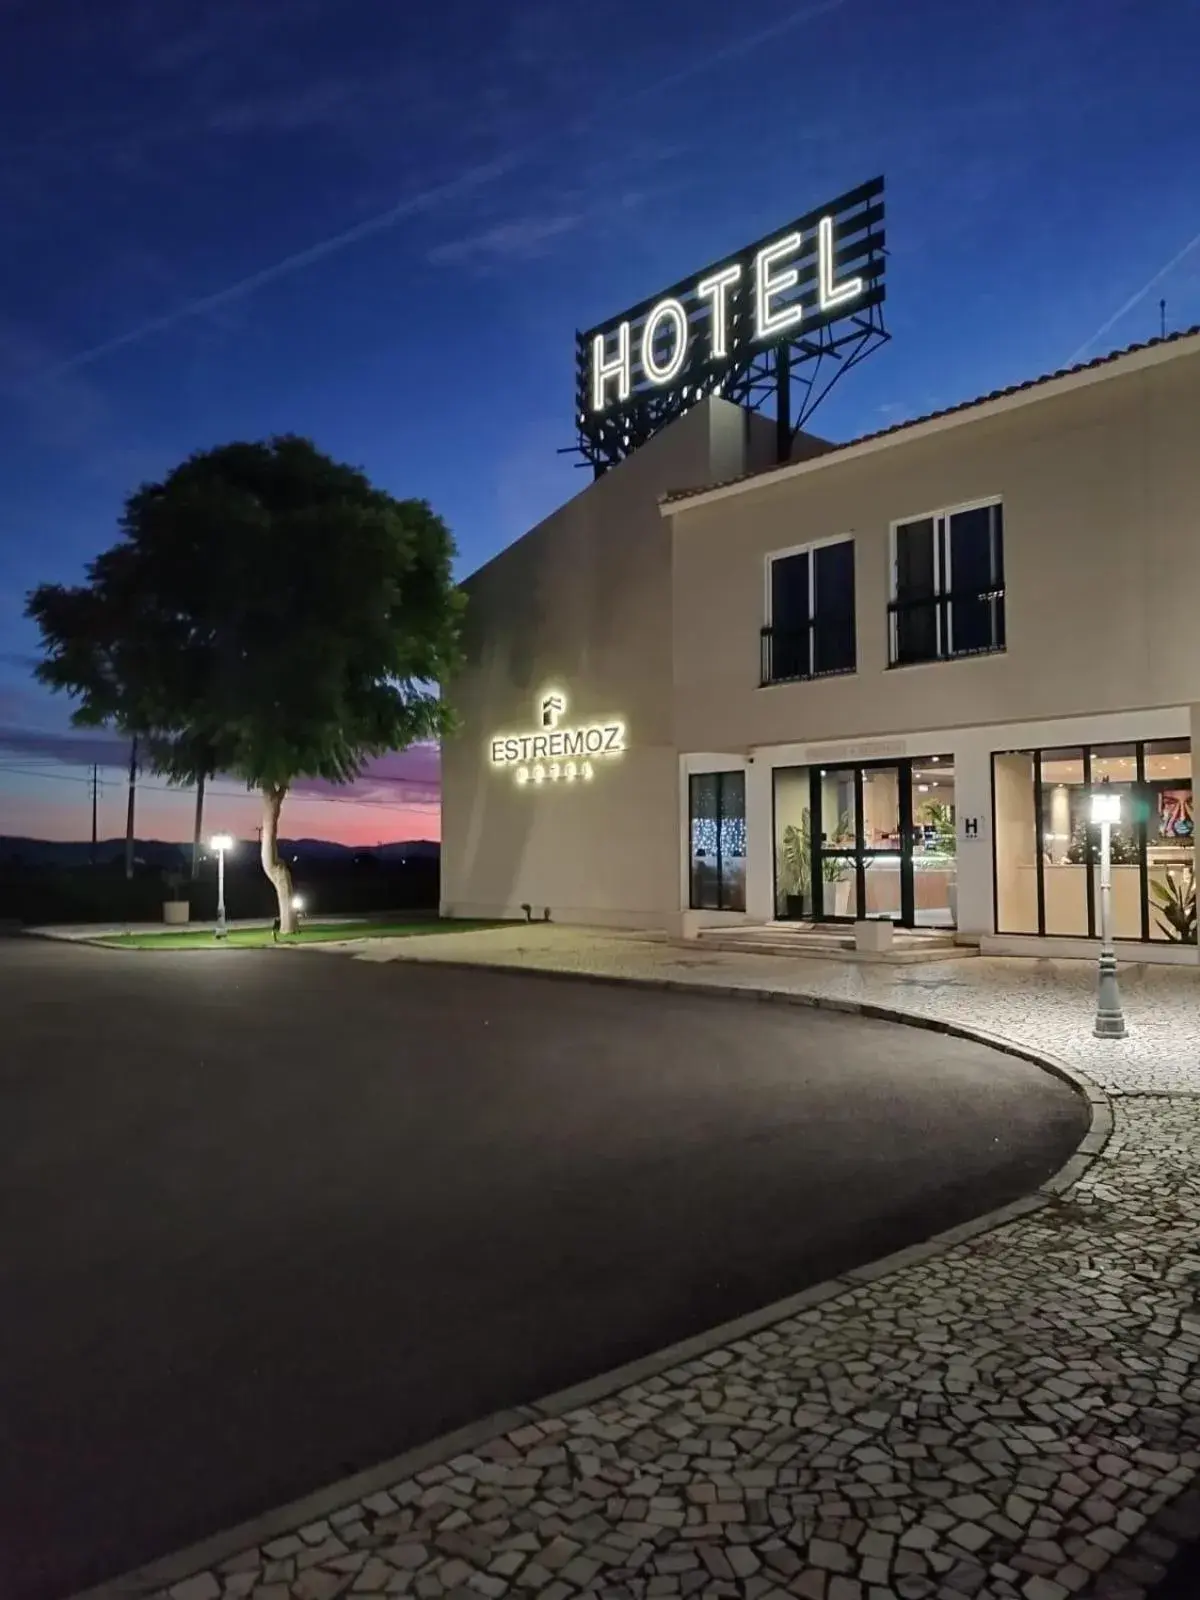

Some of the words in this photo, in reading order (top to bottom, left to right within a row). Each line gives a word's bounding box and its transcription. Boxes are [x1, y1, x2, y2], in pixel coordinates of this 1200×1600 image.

[592, 215, 863, 411] HOTEL
[492, 727, 620, 762] ESTREMOZ
[965, 818, 978, 834] H
